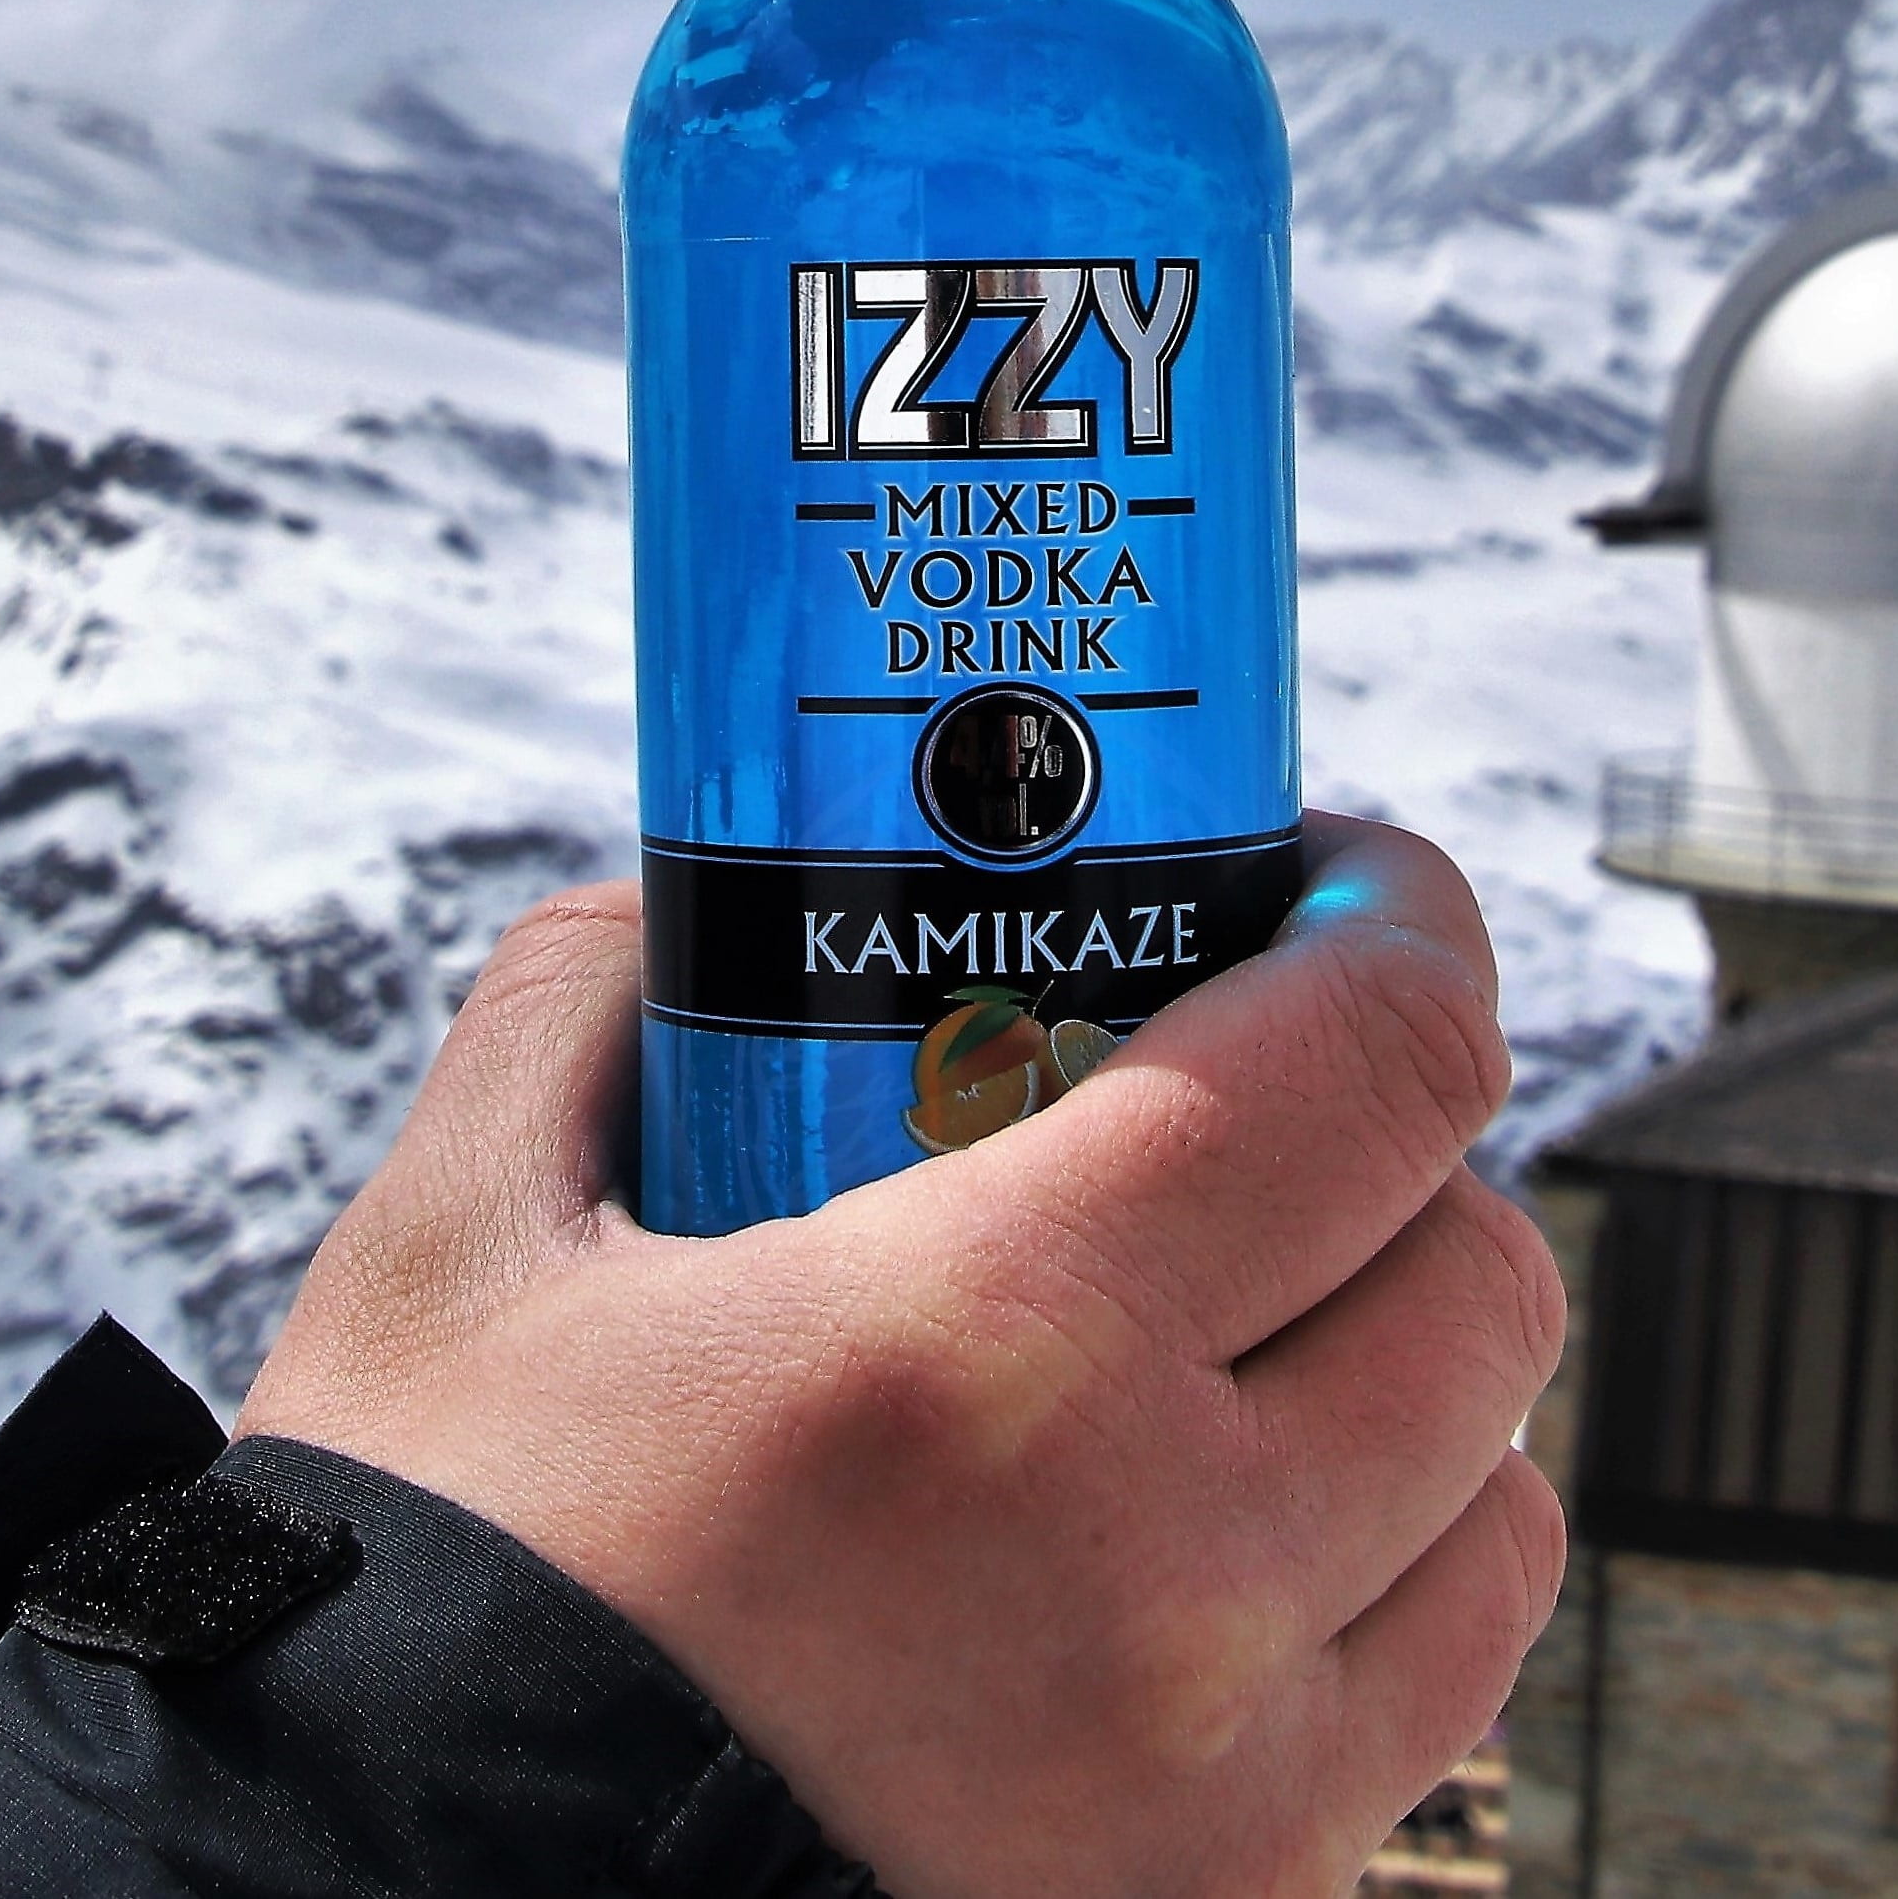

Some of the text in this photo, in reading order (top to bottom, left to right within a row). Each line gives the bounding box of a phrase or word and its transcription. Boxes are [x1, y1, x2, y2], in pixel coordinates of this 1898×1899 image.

[791, 258, 1199, 461] IZZY
[886, 482, 1117, 537] MIXED
[847, 547, 1154, 609] VODKA
[887, 618, 1119, 675] DRINK
[803, 902, 1200, 976] KAMIKAZE
